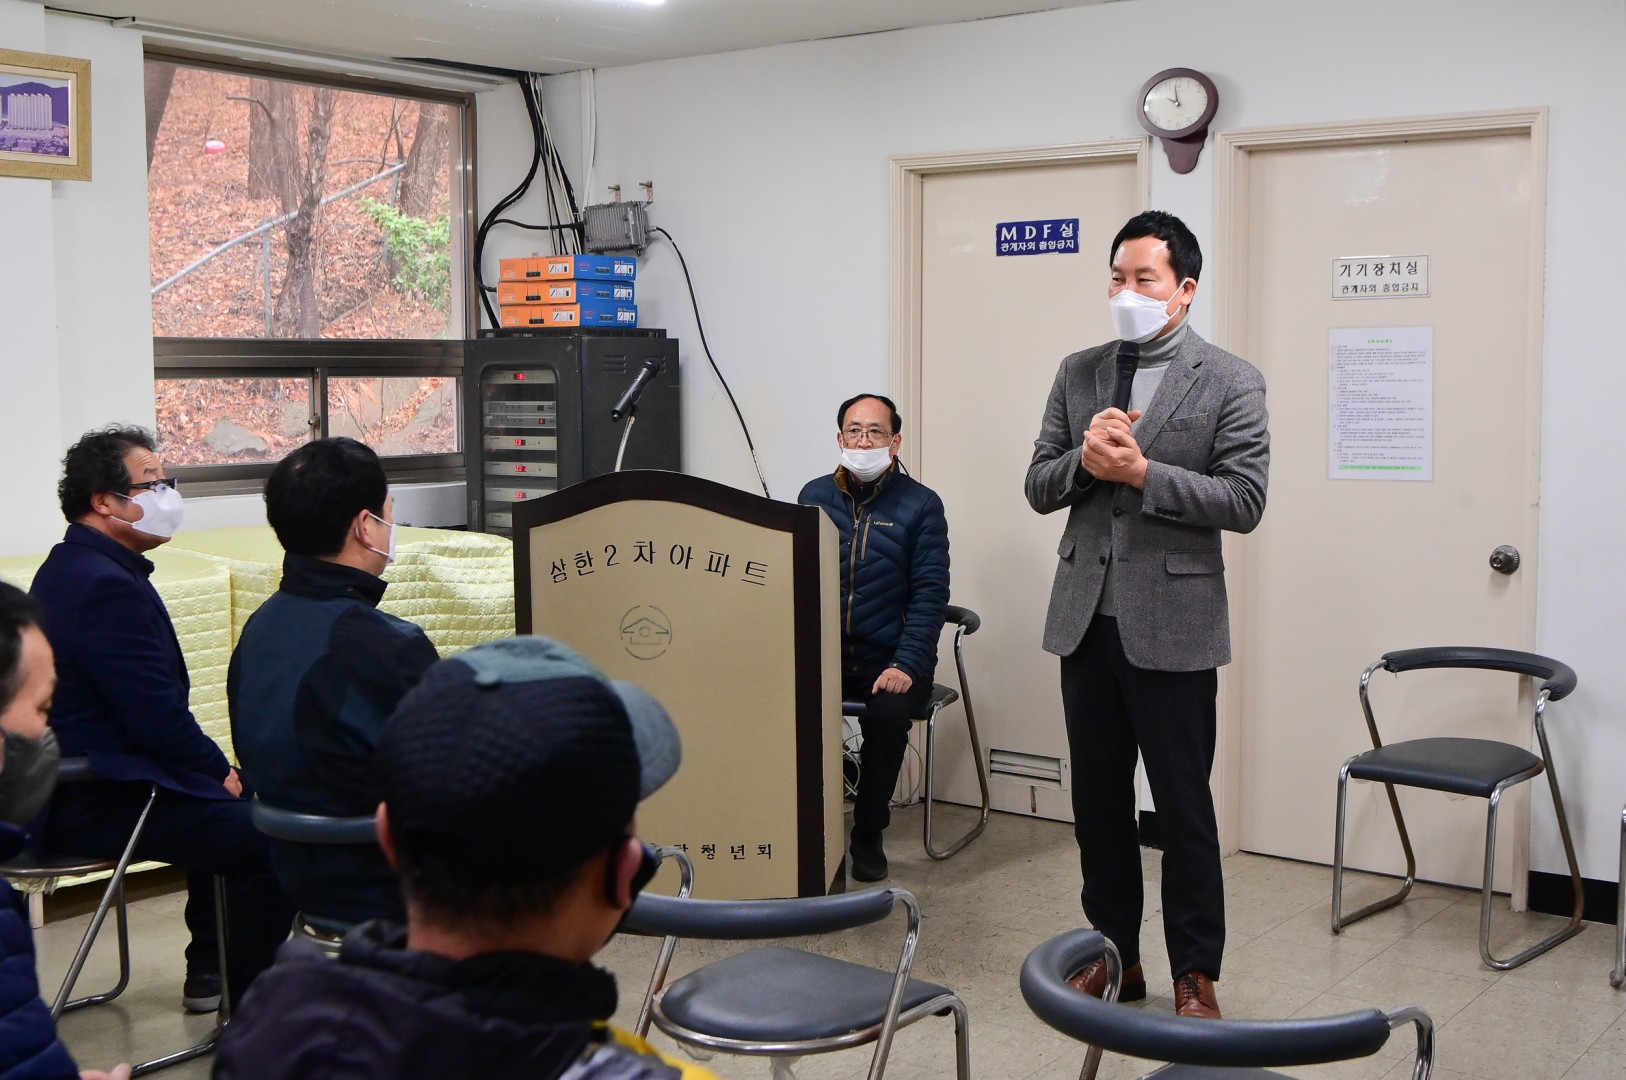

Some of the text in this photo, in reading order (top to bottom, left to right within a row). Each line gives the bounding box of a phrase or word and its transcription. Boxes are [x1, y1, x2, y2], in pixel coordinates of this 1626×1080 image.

[1001, 239, 1074, 252] 관계자외 출입금지
[1339, 261, 1418, 277] 기기장치실
[1341, 282, 1419, 294] 관계자외 출입금지
